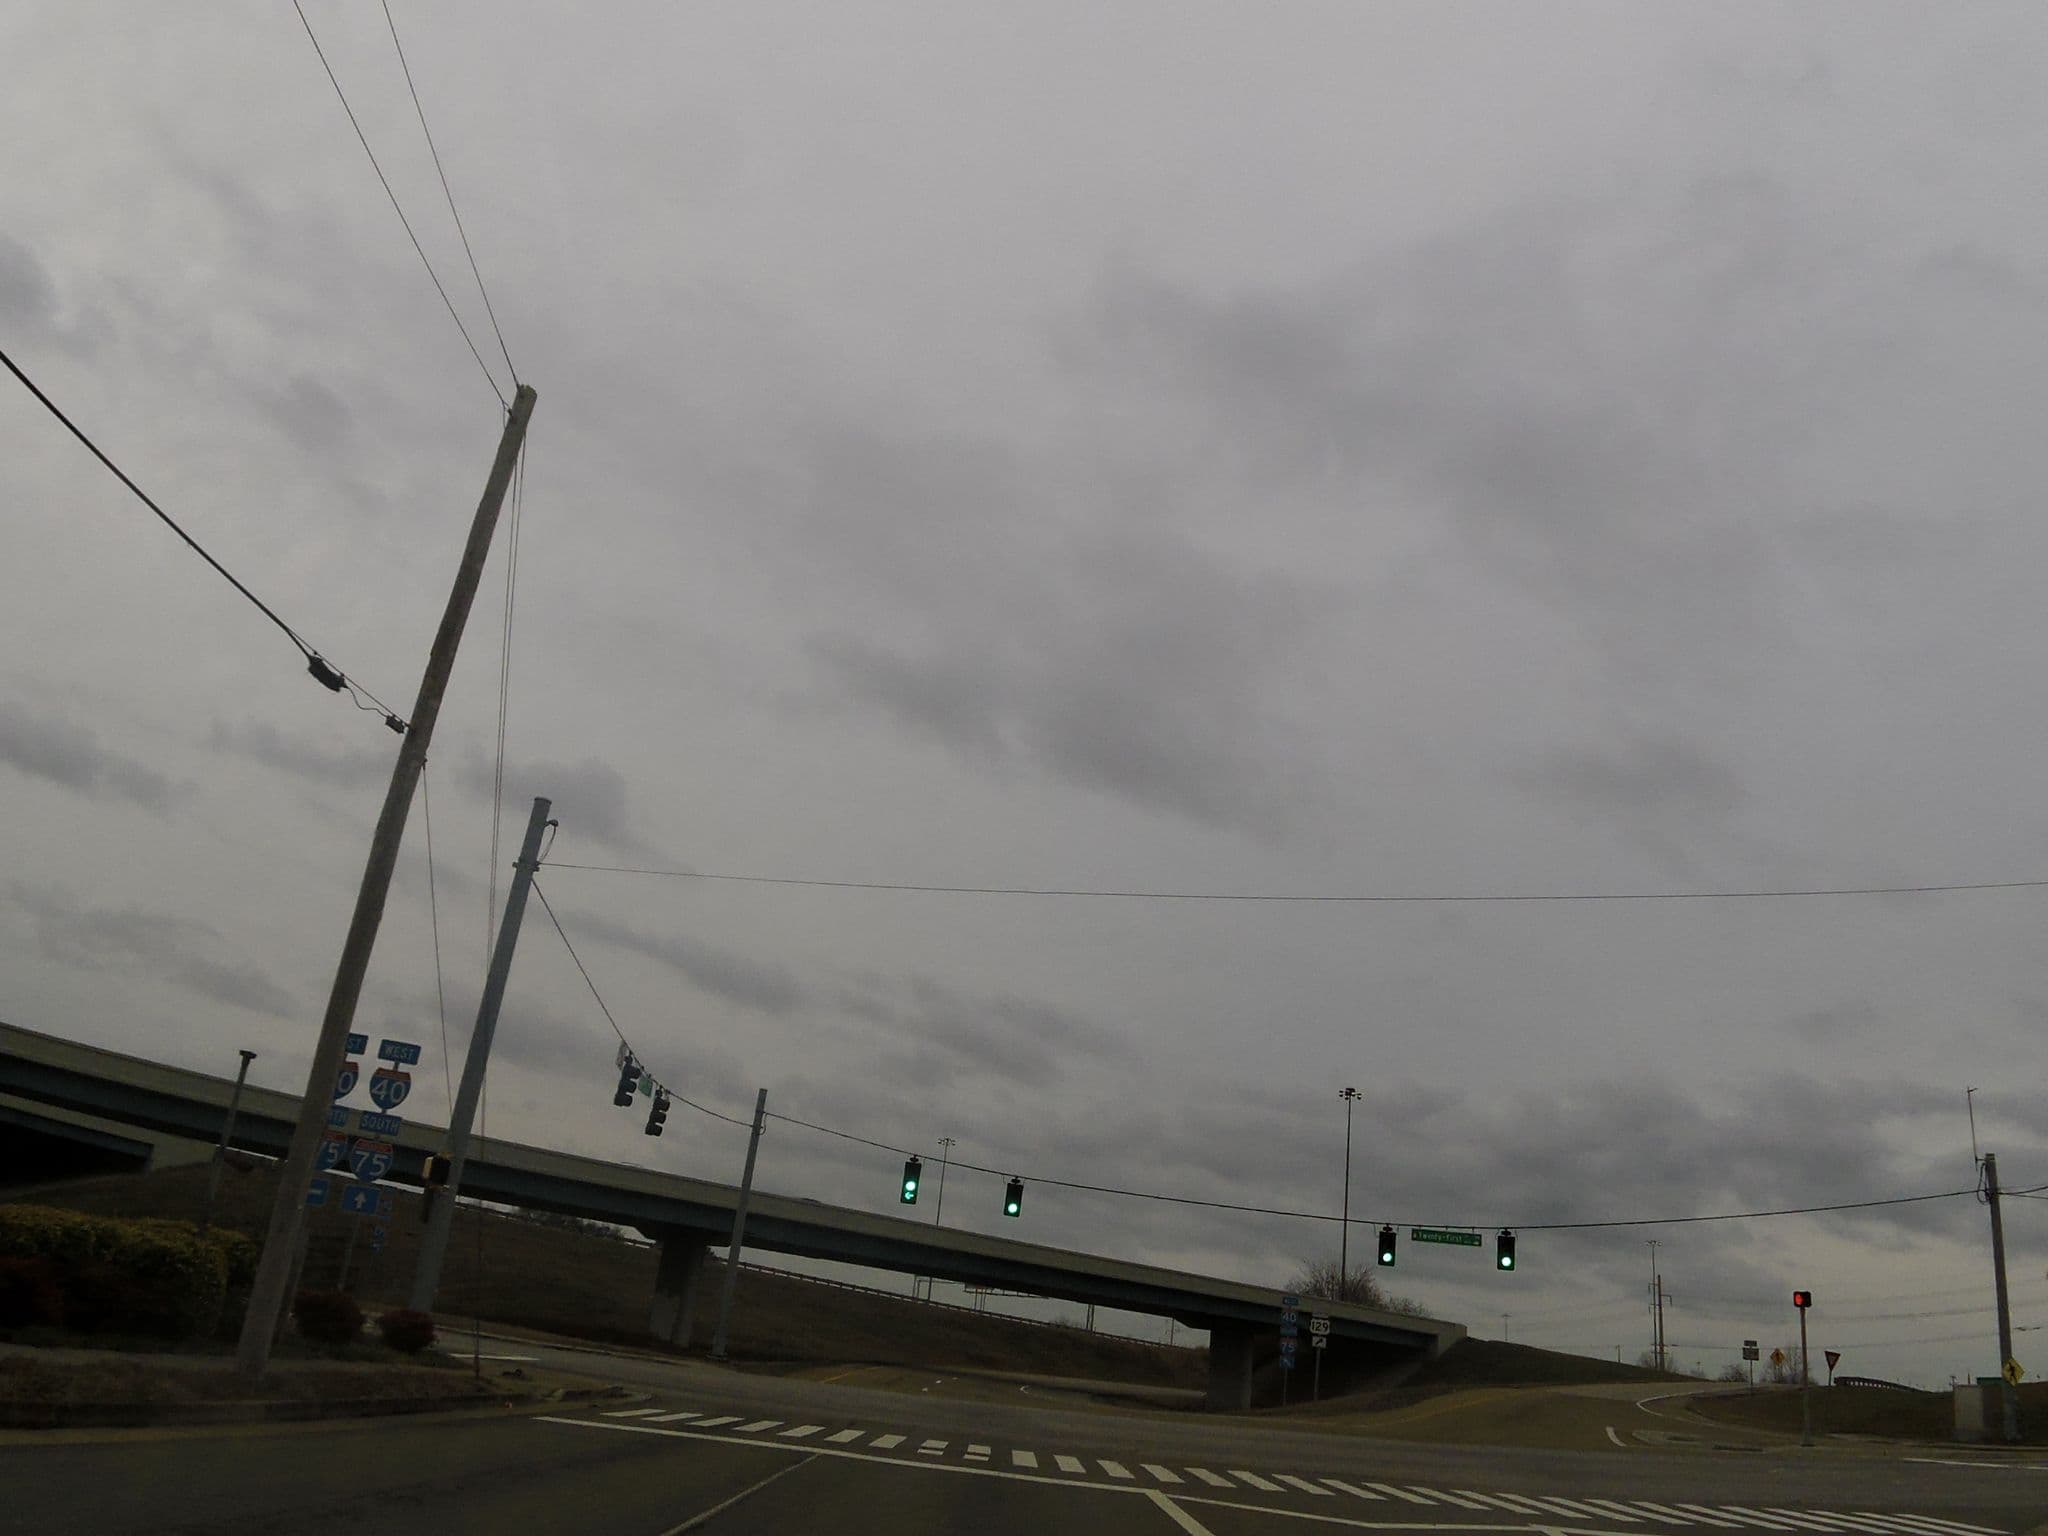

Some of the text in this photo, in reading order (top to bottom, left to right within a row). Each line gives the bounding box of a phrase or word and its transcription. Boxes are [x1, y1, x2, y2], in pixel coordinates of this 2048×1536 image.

[385, 1045, 415, 1059] WEST
[338, 1071, 354, 1094] 0
[371, 1078, 406, 1103] 40
[361, 1117, 399, 1134] SOUTH
[325, 1143, 341, 1163] 5
[354, 1150, 387, 1176] 75
[1311, 1321, 1328, 1332] 129
